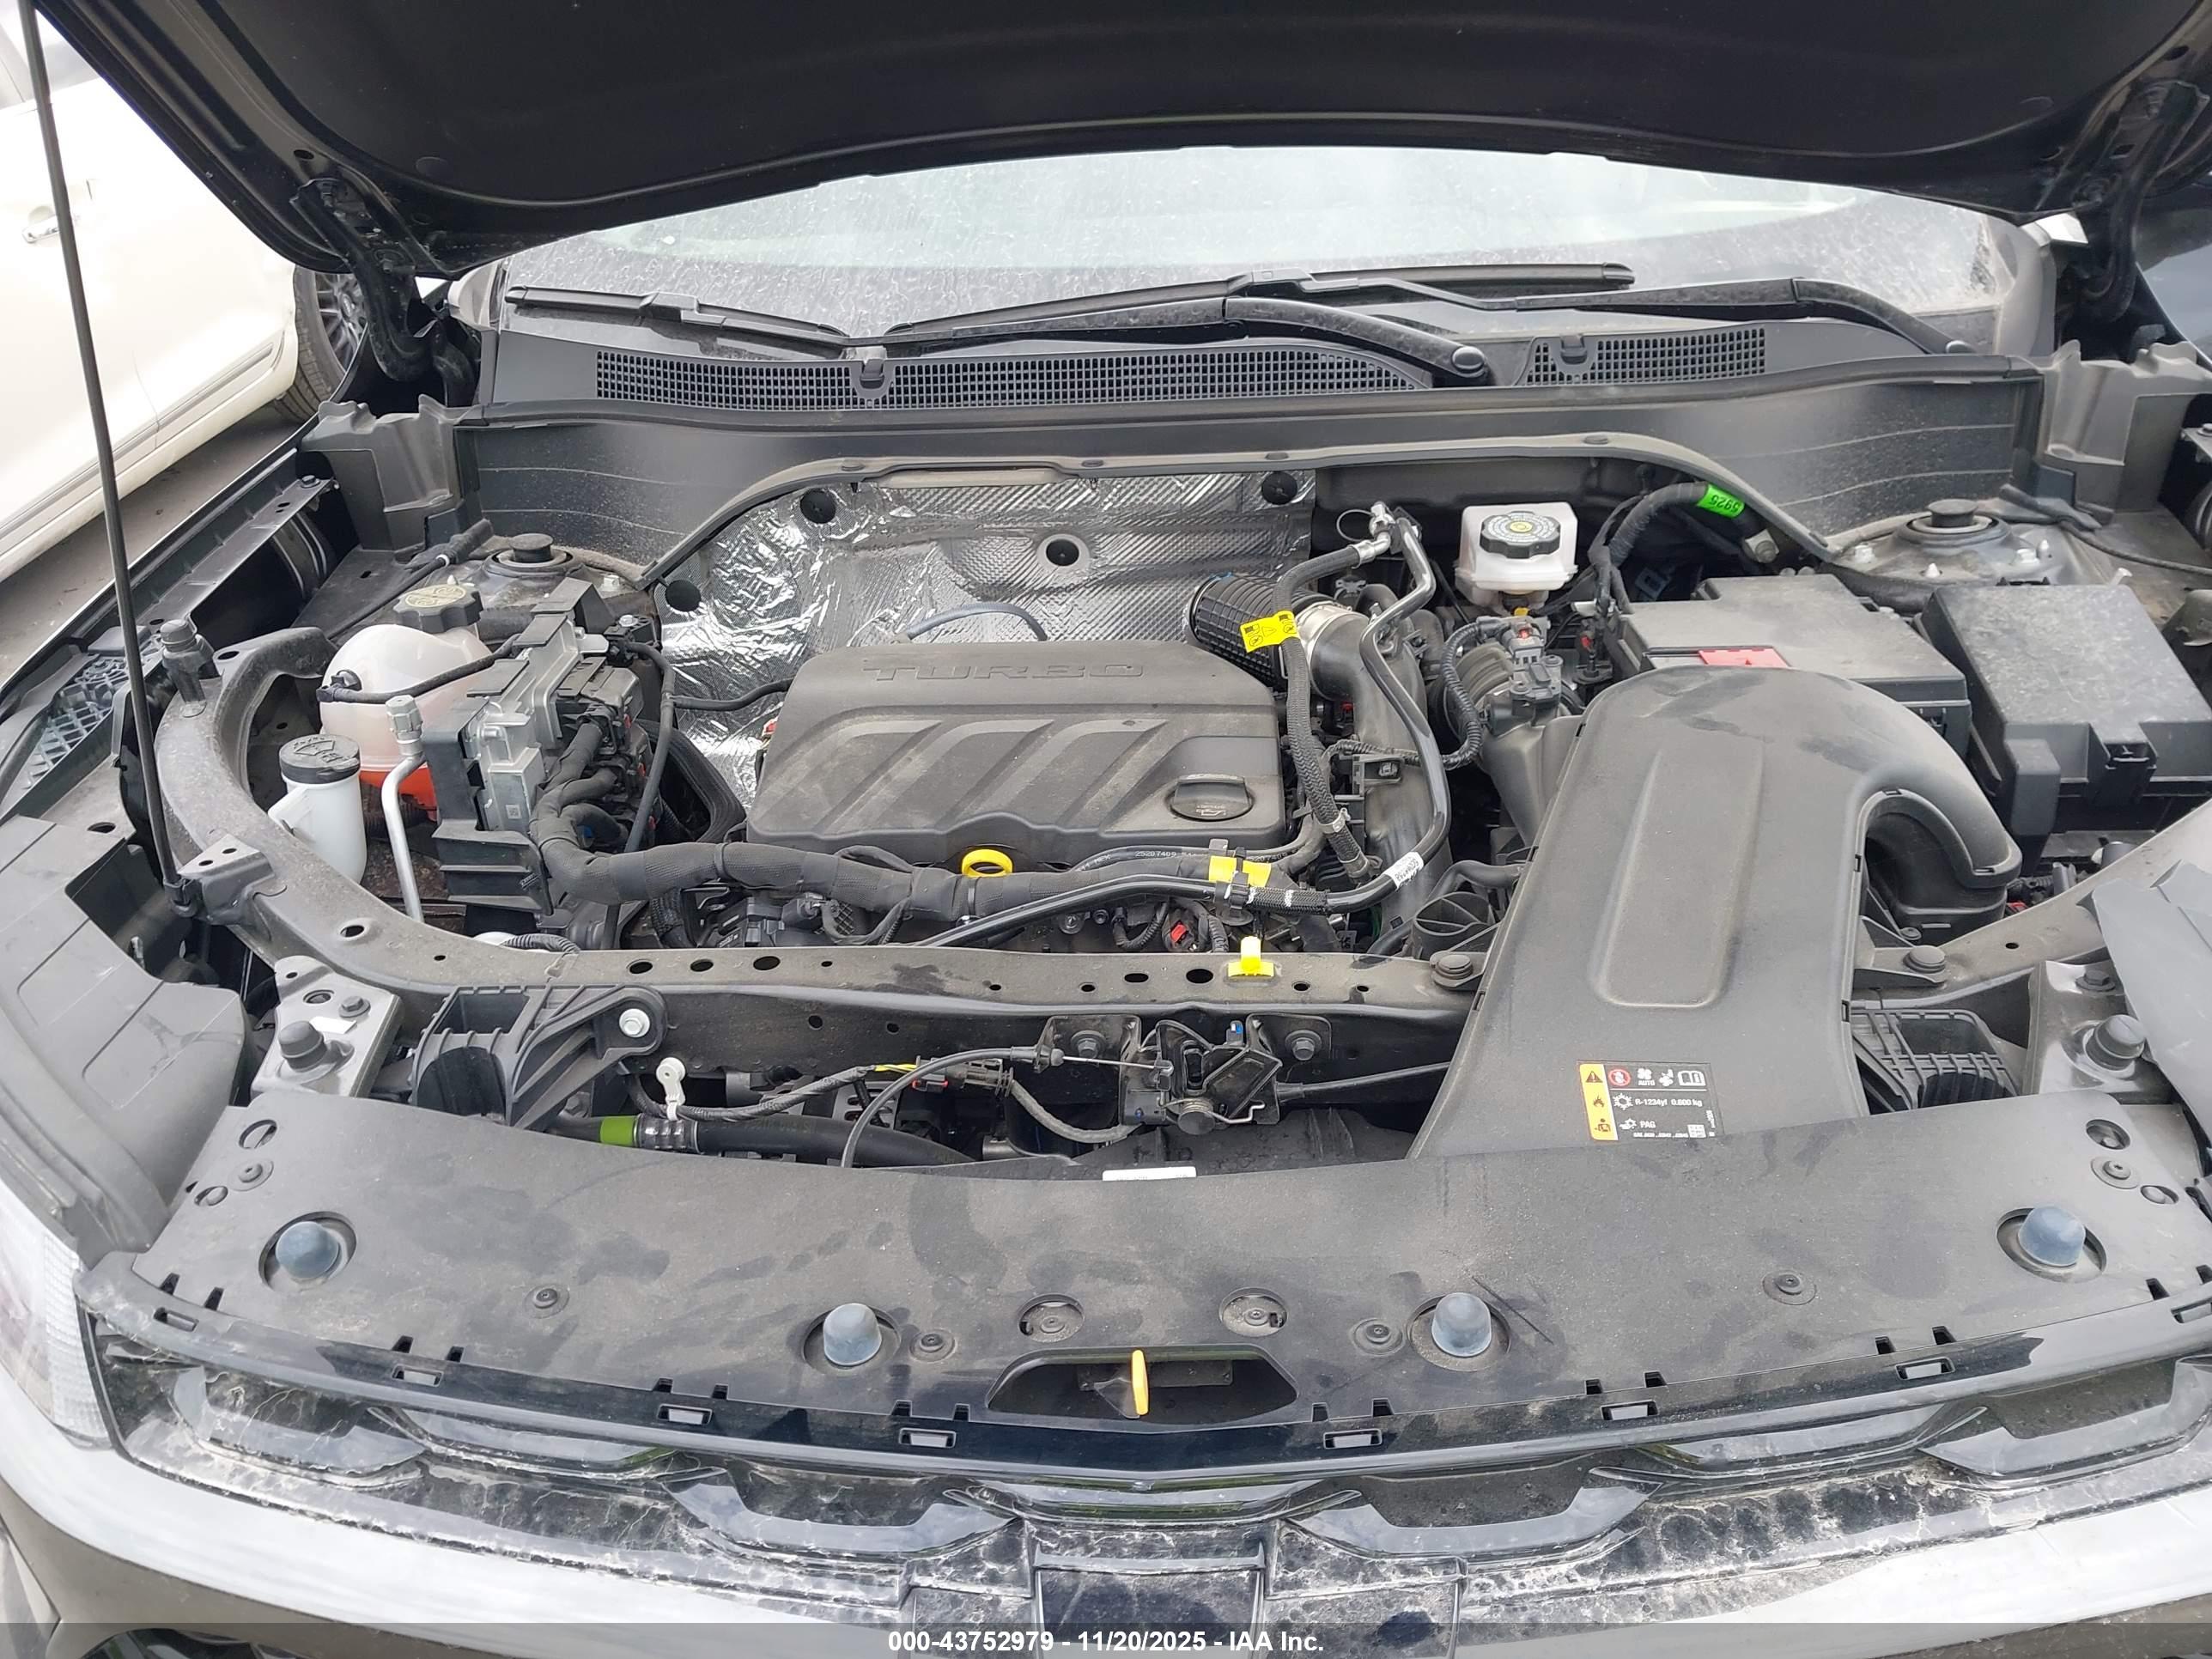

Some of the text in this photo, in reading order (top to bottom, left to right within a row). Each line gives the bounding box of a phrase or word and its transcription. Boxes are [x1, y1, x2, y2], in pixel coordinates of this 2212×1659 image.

[861, 664, 1145, 682] TURBO
[1692, 1098, 1703, 1108] kg
[1639, 1120, 1656, 1128] PAG
